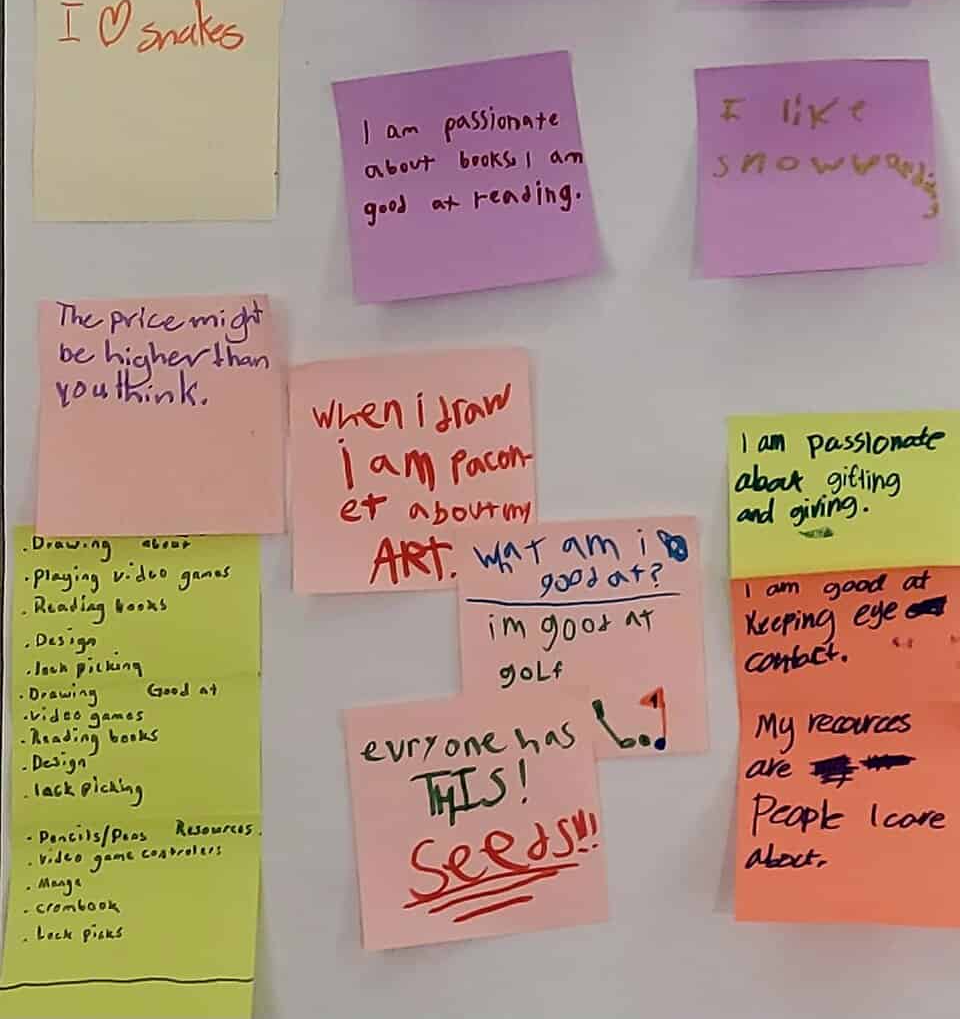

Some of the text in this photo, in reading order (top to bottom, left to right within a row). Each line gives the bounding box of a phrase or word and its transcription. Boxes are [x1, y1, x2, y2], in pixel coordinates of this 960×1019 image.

[58, 1, 84, 41] I
[720, 97, 746, 121] I
[387, 124, 418, 139] am
[445, 106, 559, 143] passionate
[365, 155, 435, 178] about
[550, 150, 583, 164] am
[364, 181, 580, 226] good at reading.
[56, 300, 263, 343] The price might
[59, 339, 269, 389] be higher than
[56, 370, 208, 407] you think.
[436, 383, 511, 432] draw
[758, 433, 785, 451] am
[808, 426, 945, 459] passionate
[370, 450, 435, 491] am
[735, 464, 900, 496] about gifting
[409, 501, 499, 525] about
[737, 495, 869, 526] and giving.
[370, 536, 456, 585] ART.
[563, 534, 620, 560] am
[113, 562, 231, 591] video games
[541, 563, 663, 597] good at?
[767, 582, 799, 597] am
[823, 574, 887, 600] good
[903, 570, 931, 590] at
[34, 595, 105, 624] Reading
[854, 601, 898, 629] eye
[35, 627, 96, 653] Design
[542, 614, 611, 651] good
[30, 682, 217, 707] Drawing Good at
[89, 710, 143, 728] games
[755, 713, 794, 754] My
[32, 728, 158, 755] Reading books
[361, 722, 575, 762] evryone has
[32, 752, 86, 774] Design
[745, 757, 792, 778] are
[884, 810, 946, 828] care
[90, 850, 134, 873] game
